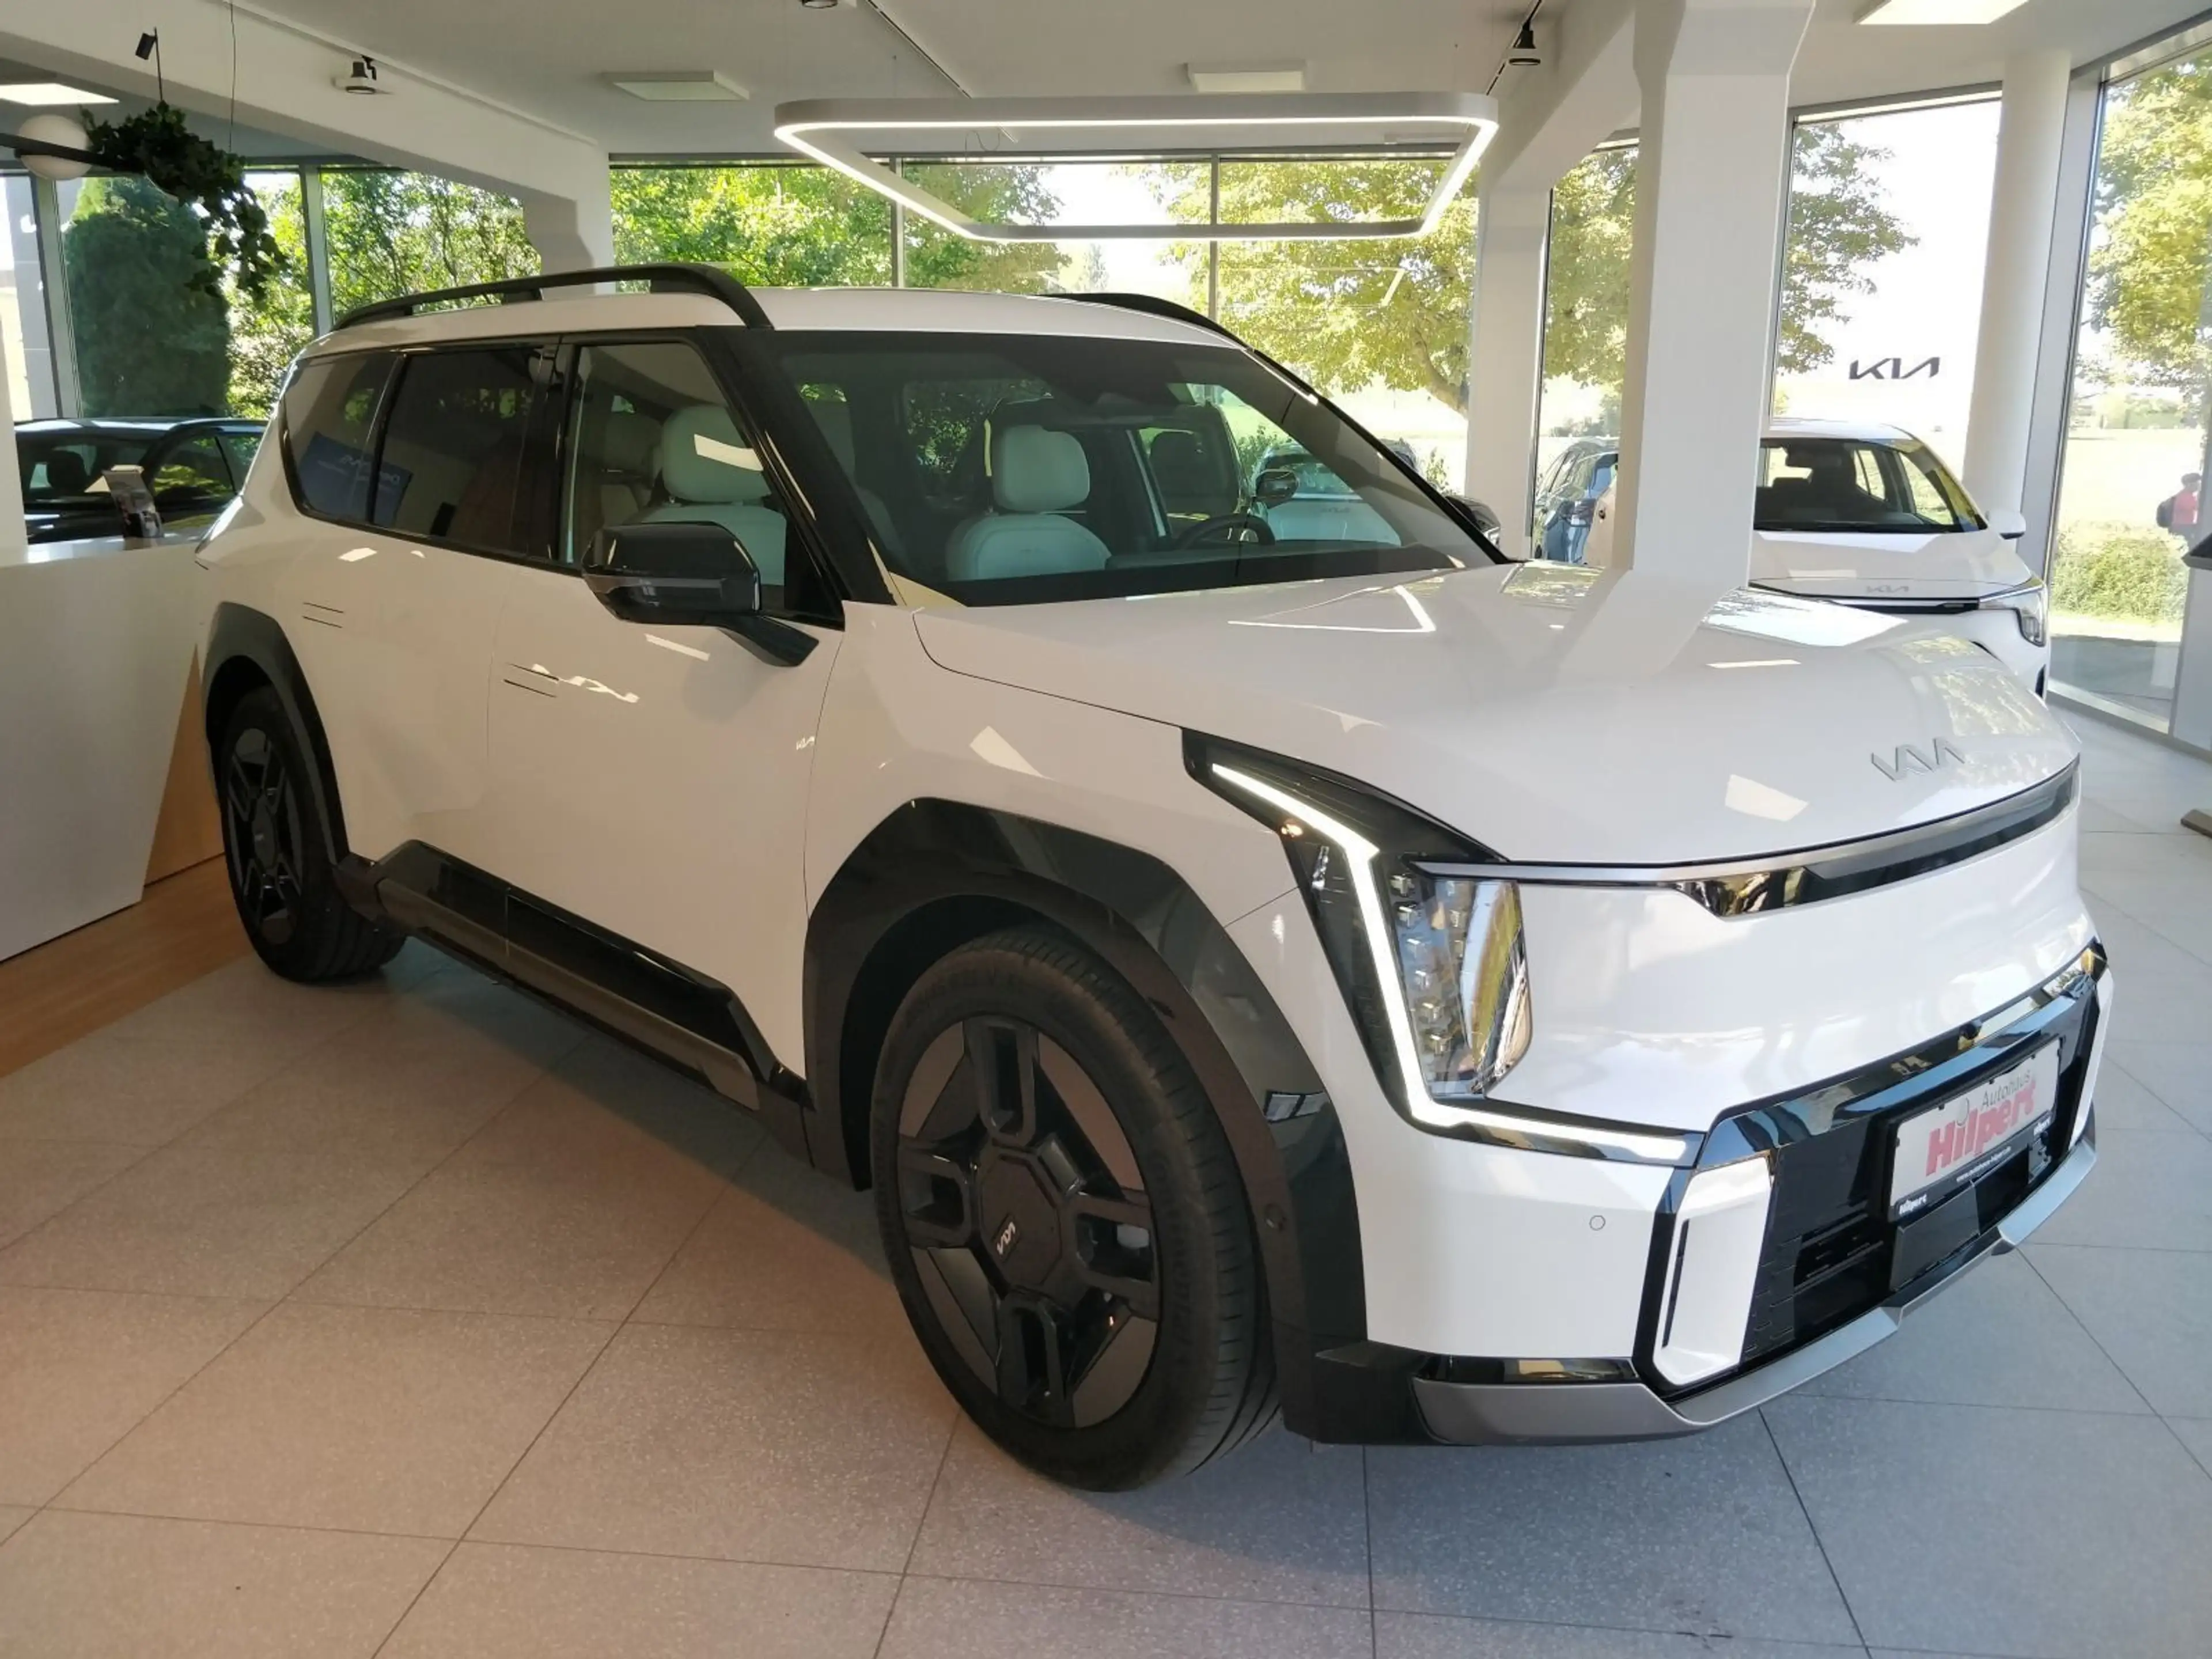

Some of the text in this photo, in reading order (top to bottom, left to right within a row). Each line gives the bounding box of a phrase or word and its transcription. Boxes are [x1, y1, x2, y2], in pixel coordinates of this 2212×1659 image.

[1849, 357, 1940, 380] KIA
[1866, 585, 1909, 594] KIA
[1871, 738, 1965, 781] KIA
[1926, 1077, 2035, 1177] Hilpert
